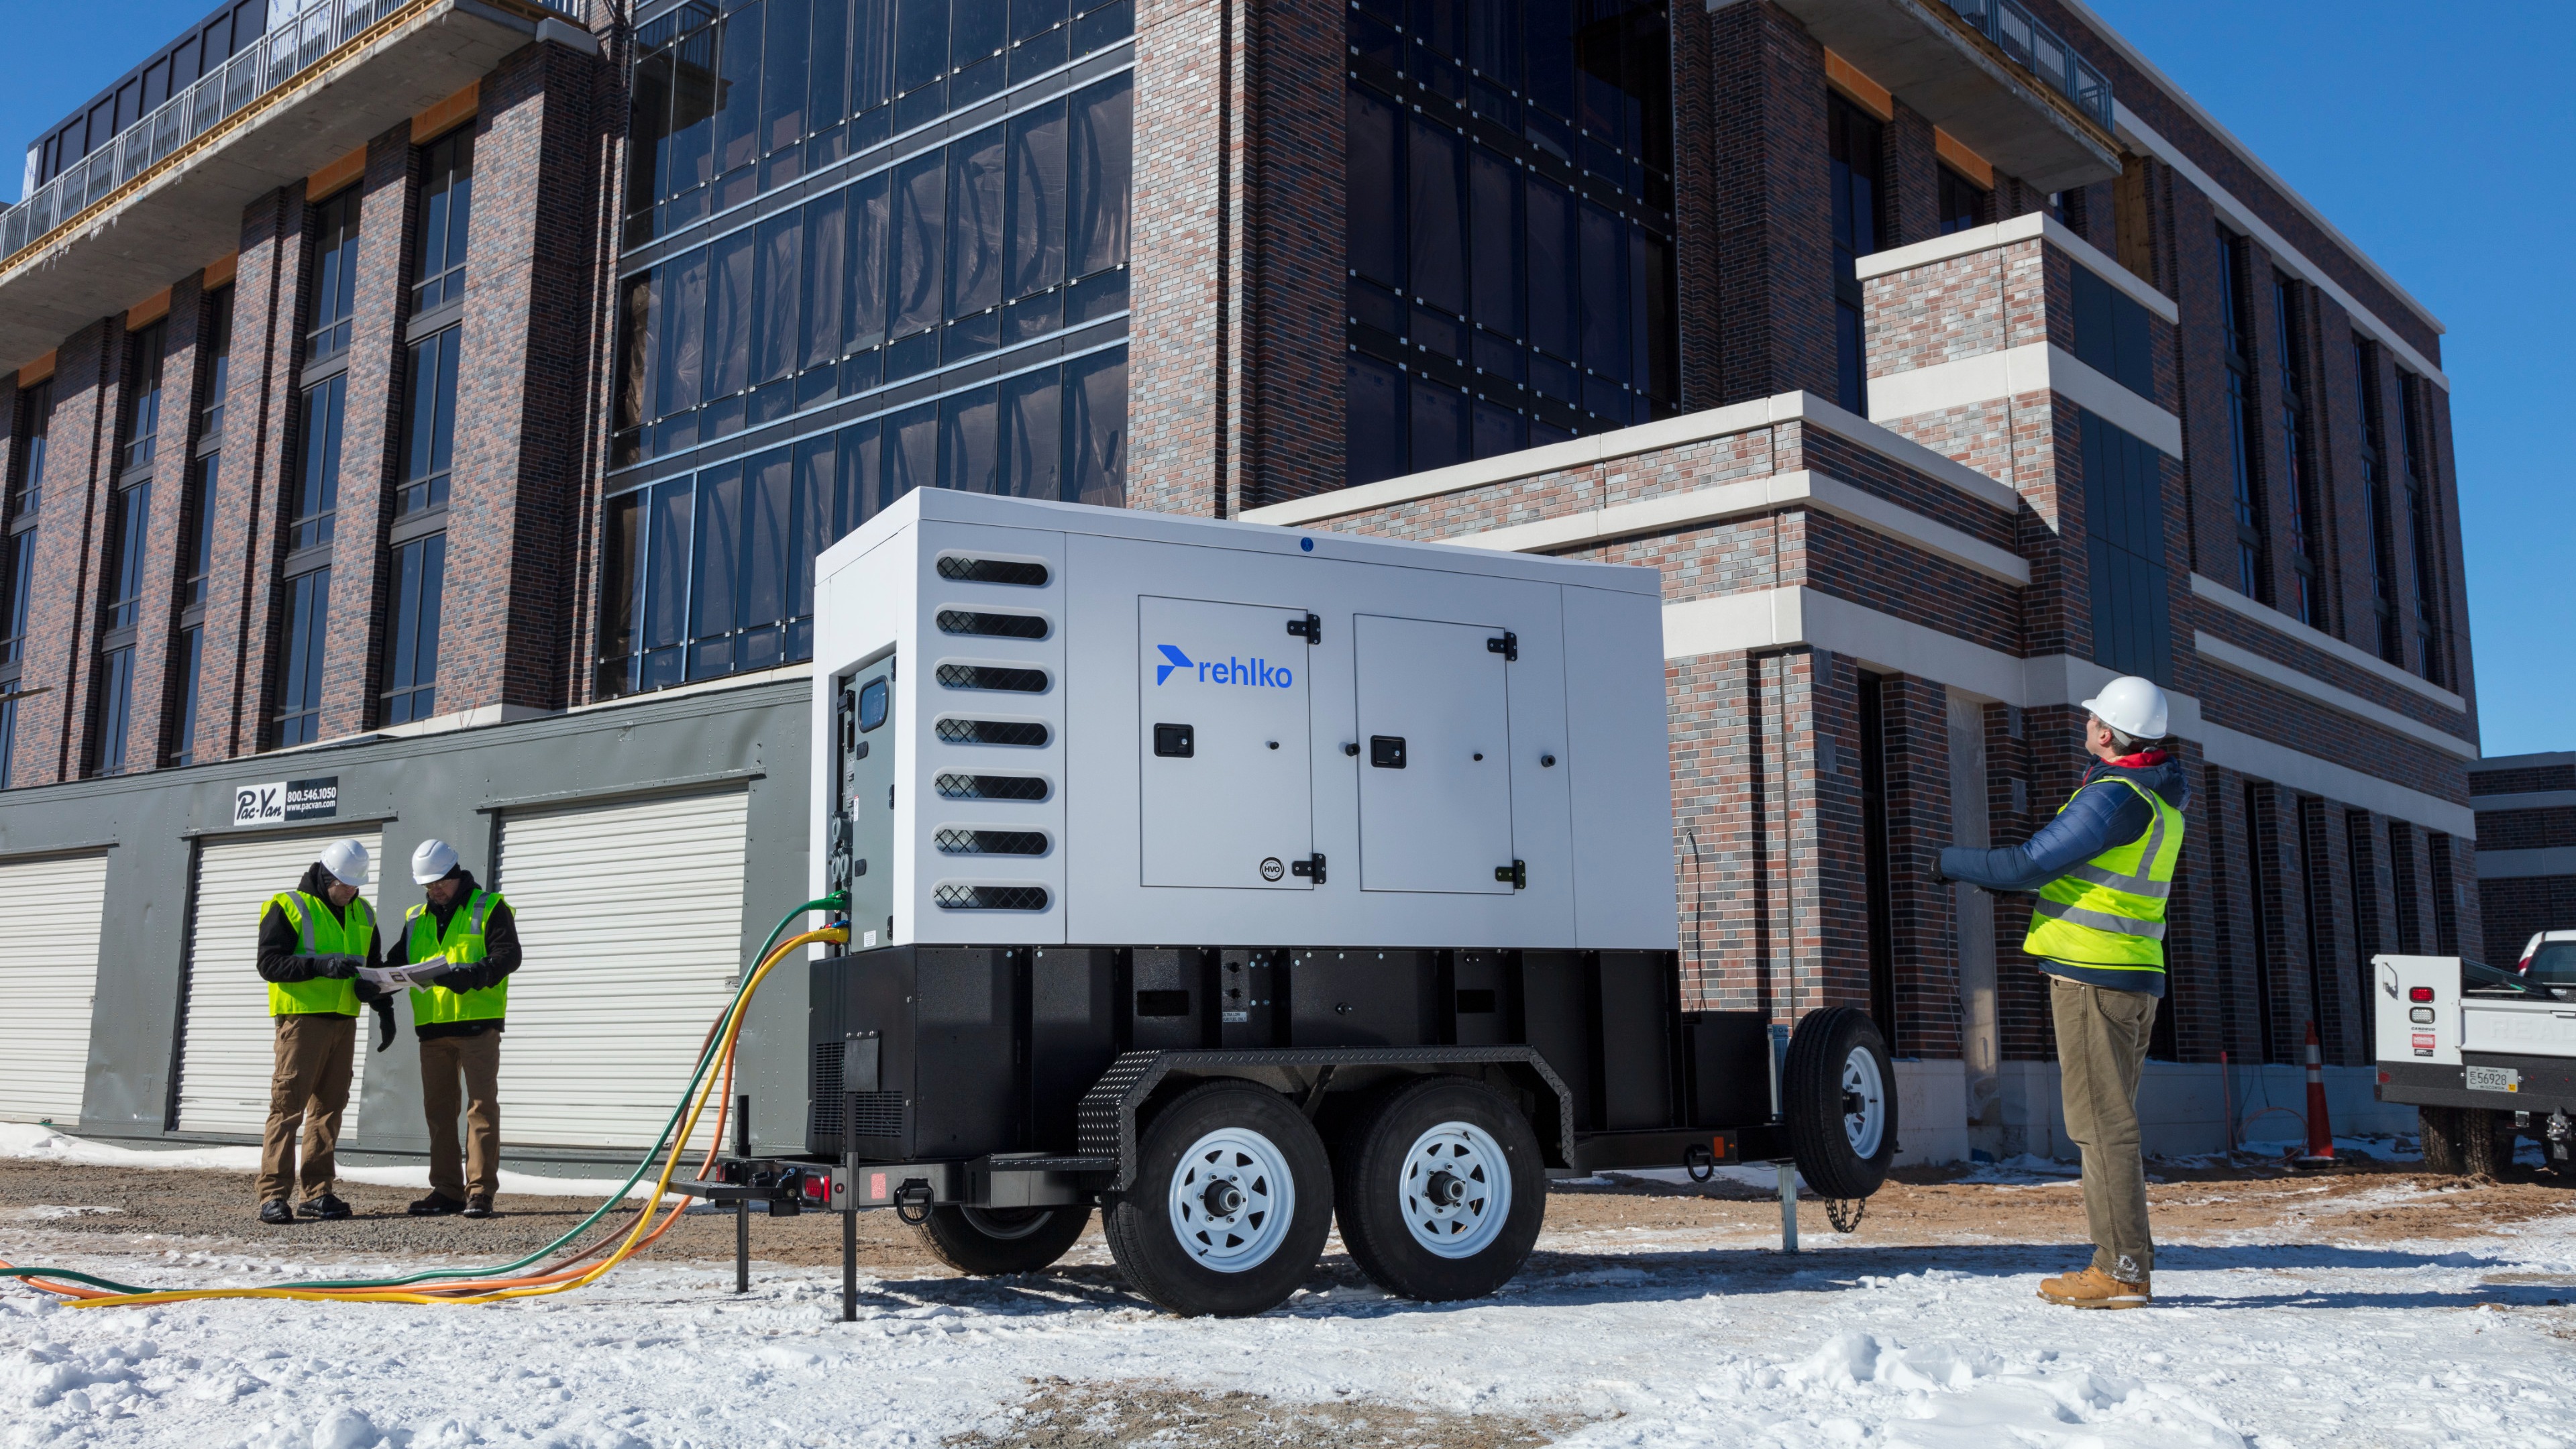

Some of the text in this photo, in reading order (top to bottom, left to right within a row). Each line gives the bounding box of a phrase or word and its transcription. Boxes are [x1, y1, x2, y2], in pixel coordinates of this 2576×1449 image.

[1199, 656, 1293, 688] rehlko
[287, 787, 337, 802] 800.546.1050
[236, 788, 282, 820] Pac-Van
[286, 800, 335, 812] www.pacvan.com
[2477, 1073, 2506, 1085] 56928
